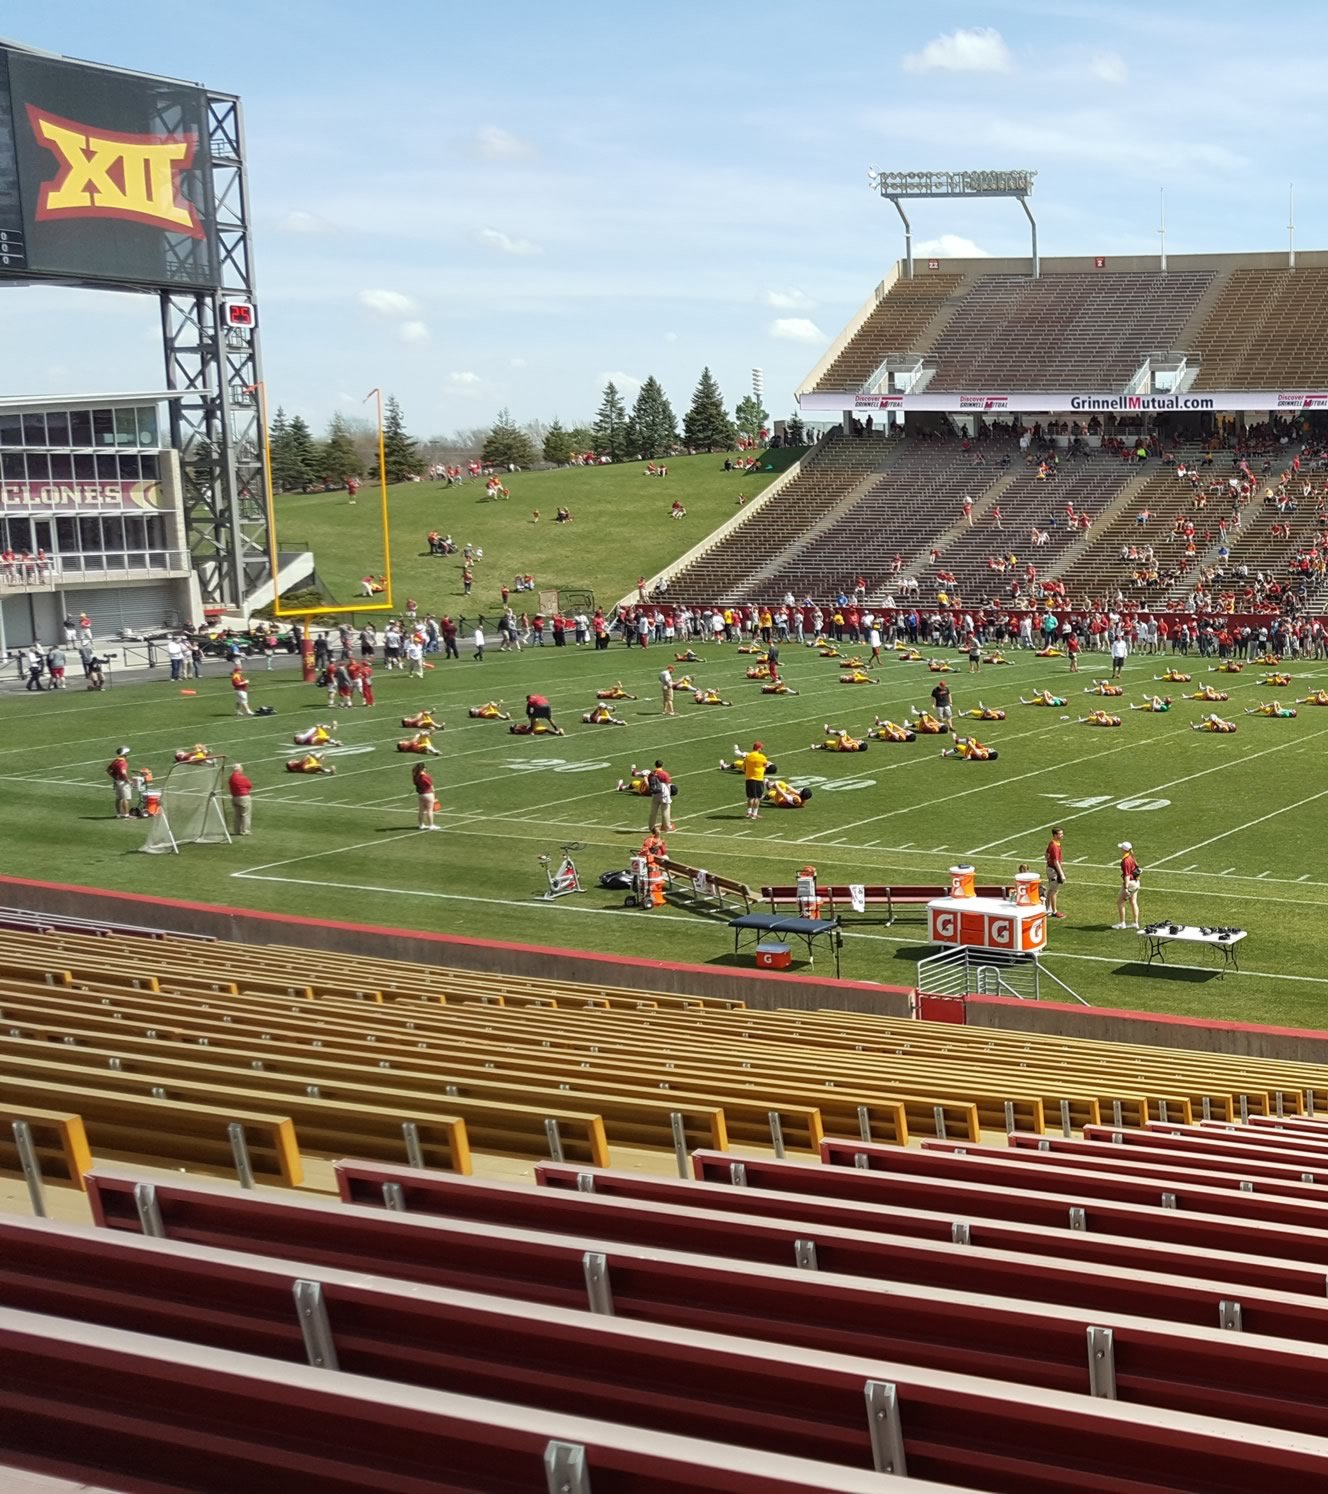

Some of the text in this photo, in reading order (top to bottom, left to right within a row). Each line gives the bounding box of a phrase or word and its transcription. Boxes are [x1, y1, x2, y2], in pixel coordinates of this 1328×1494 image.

[38, 119, 193, 228] XII
[231, 306, 250, 323] 25
[1071, 395, 1214, 410] GrinnellMutual.com
[953, 877, 960, 888] G
[1018, 885, 1026, 895] G
[936, 913, 954, 937] G
[991, 919, 1010, 943] G
[1029, 918, 1043, 944] G
[763, 954, 772, 964] G
